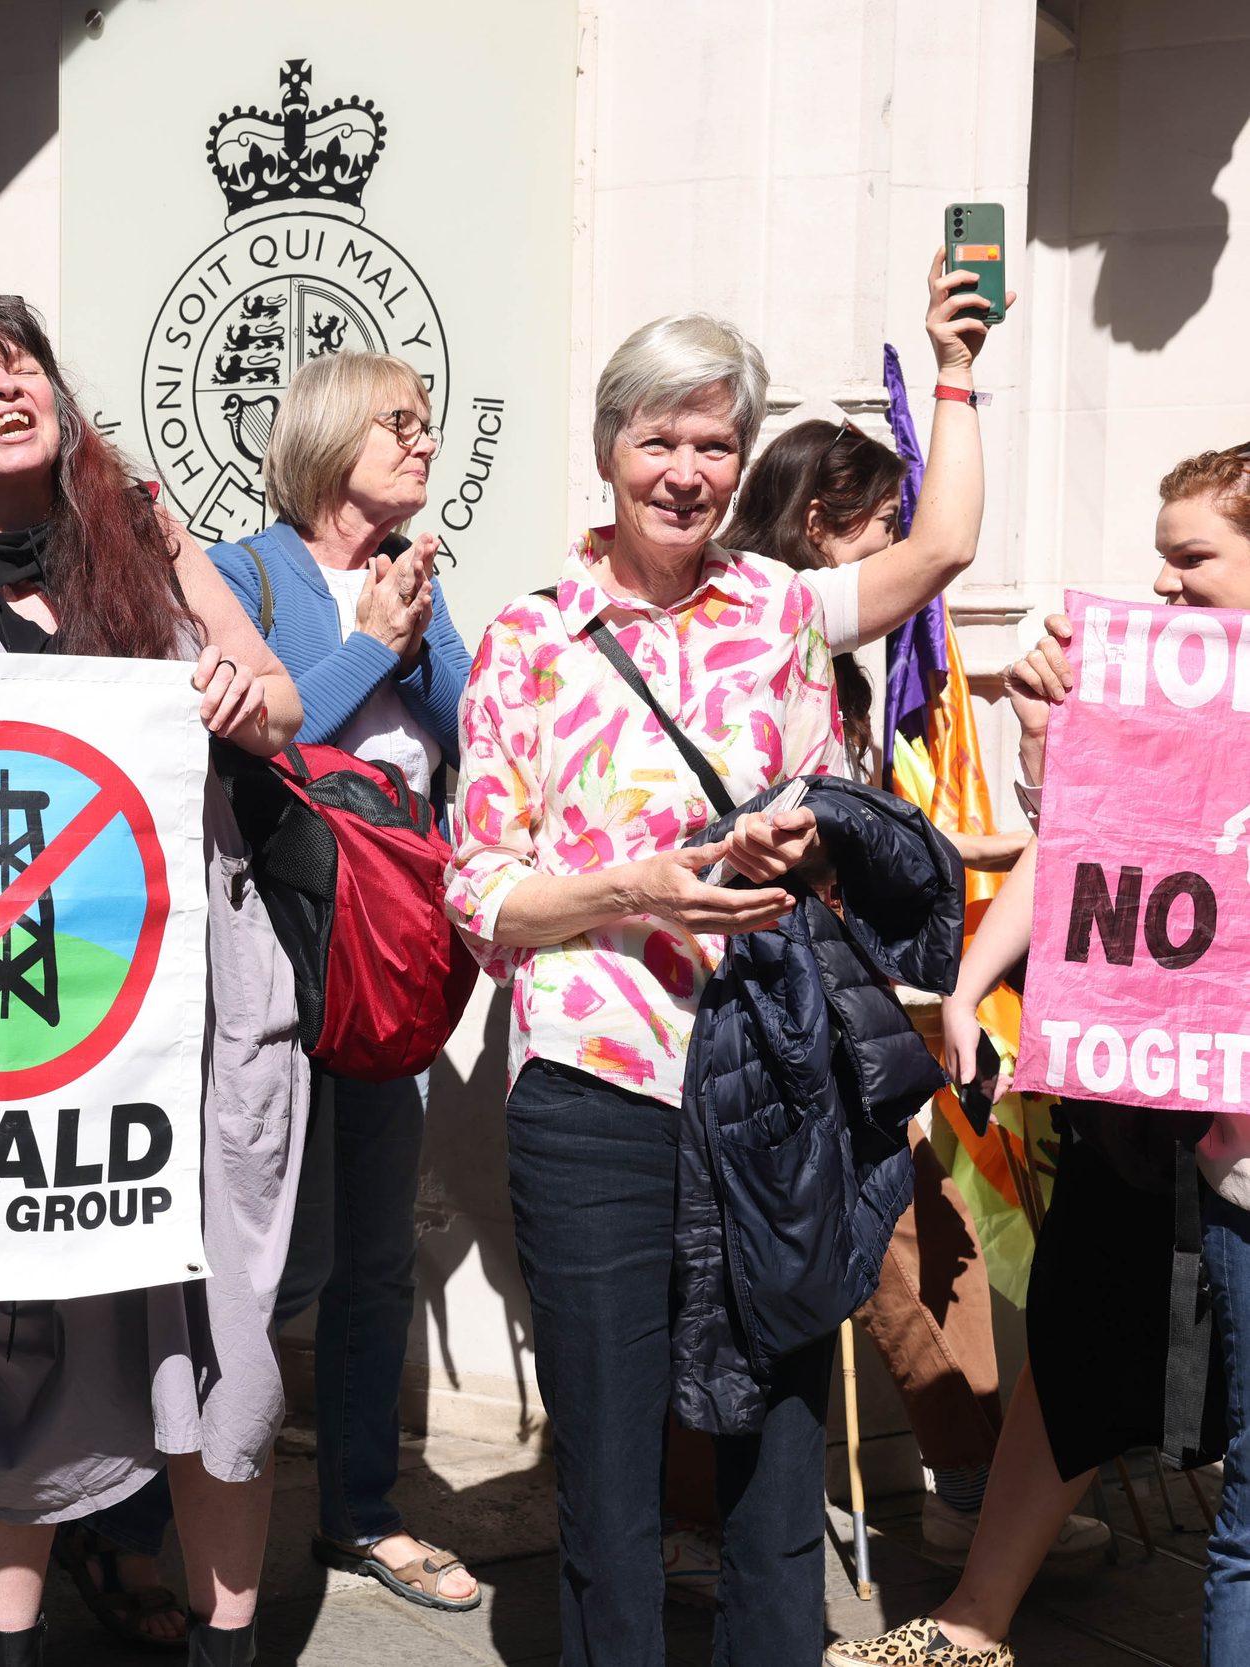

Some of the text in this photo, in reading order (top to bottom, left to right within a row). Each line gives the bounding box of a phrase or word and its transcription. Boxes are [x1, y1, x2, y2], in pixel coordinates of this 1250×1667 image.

[156, 229, 432, 485] HONI SOIT QUI MAL Y
[441, 397, 505, 531] Council
[1064, 862, 1217, 970] NO
[1041, 1020, 1250, 1103] TOGET
[6, 1186, 172, 1232] GROUP
